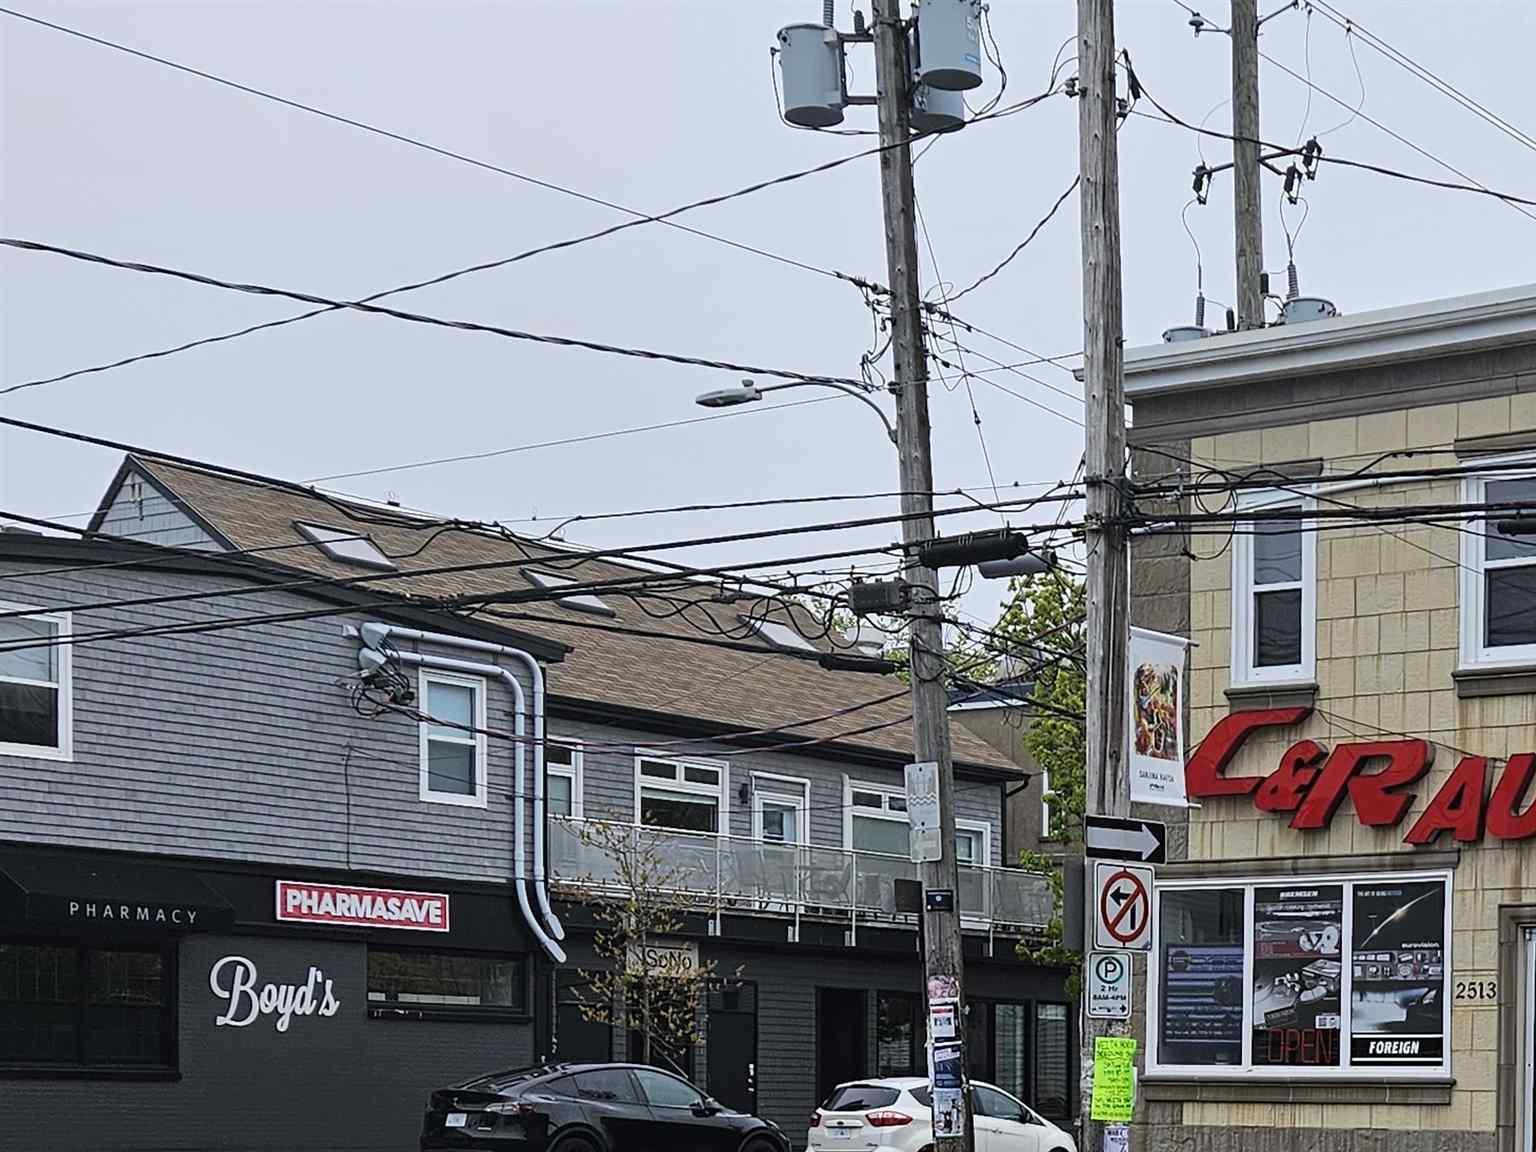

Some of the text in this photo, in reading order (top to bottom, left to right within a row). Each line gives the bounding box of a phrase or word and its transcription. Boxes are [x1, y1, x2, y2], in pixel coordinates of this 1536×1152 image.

[69, 901, 198, 925] PHARMACY
[285, 888, 443, 924] PHARMASAVE
[209, 955, 341, 1032] Boyd's
[1455, 981, 1498, 1001] 2513
[1267, 1028, 1333, 1063] OPEN
[1368, 1040, 1421, 1055] FOREIGN
